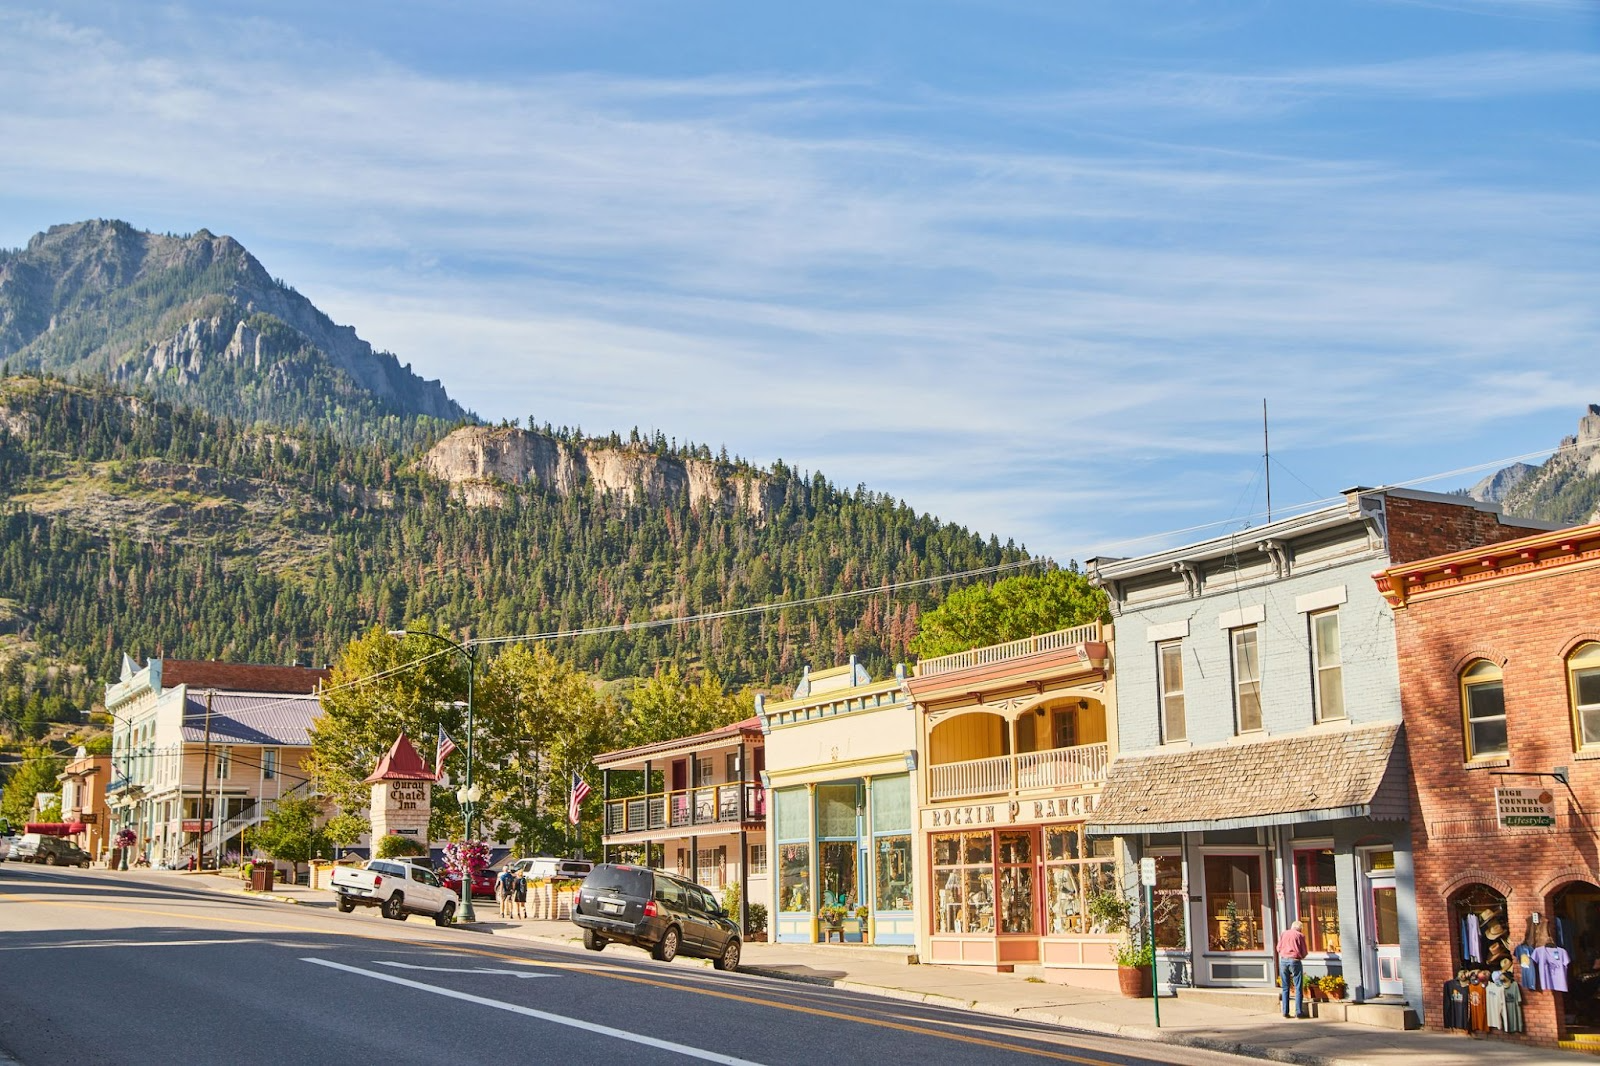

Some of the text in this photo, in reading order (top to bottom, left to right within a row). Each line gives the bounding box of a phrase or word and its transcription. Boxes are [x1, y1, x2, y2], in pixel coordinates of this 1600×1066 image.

[393, 781, 424, 791] Ouray
[390, 790, 426, 801] Chalet
[398, 800, 416, 810] Inn
[932, 795, 1095, 826] ROCKIN P RANCH
[1507, 816, 1550, 826] Lifestyles
